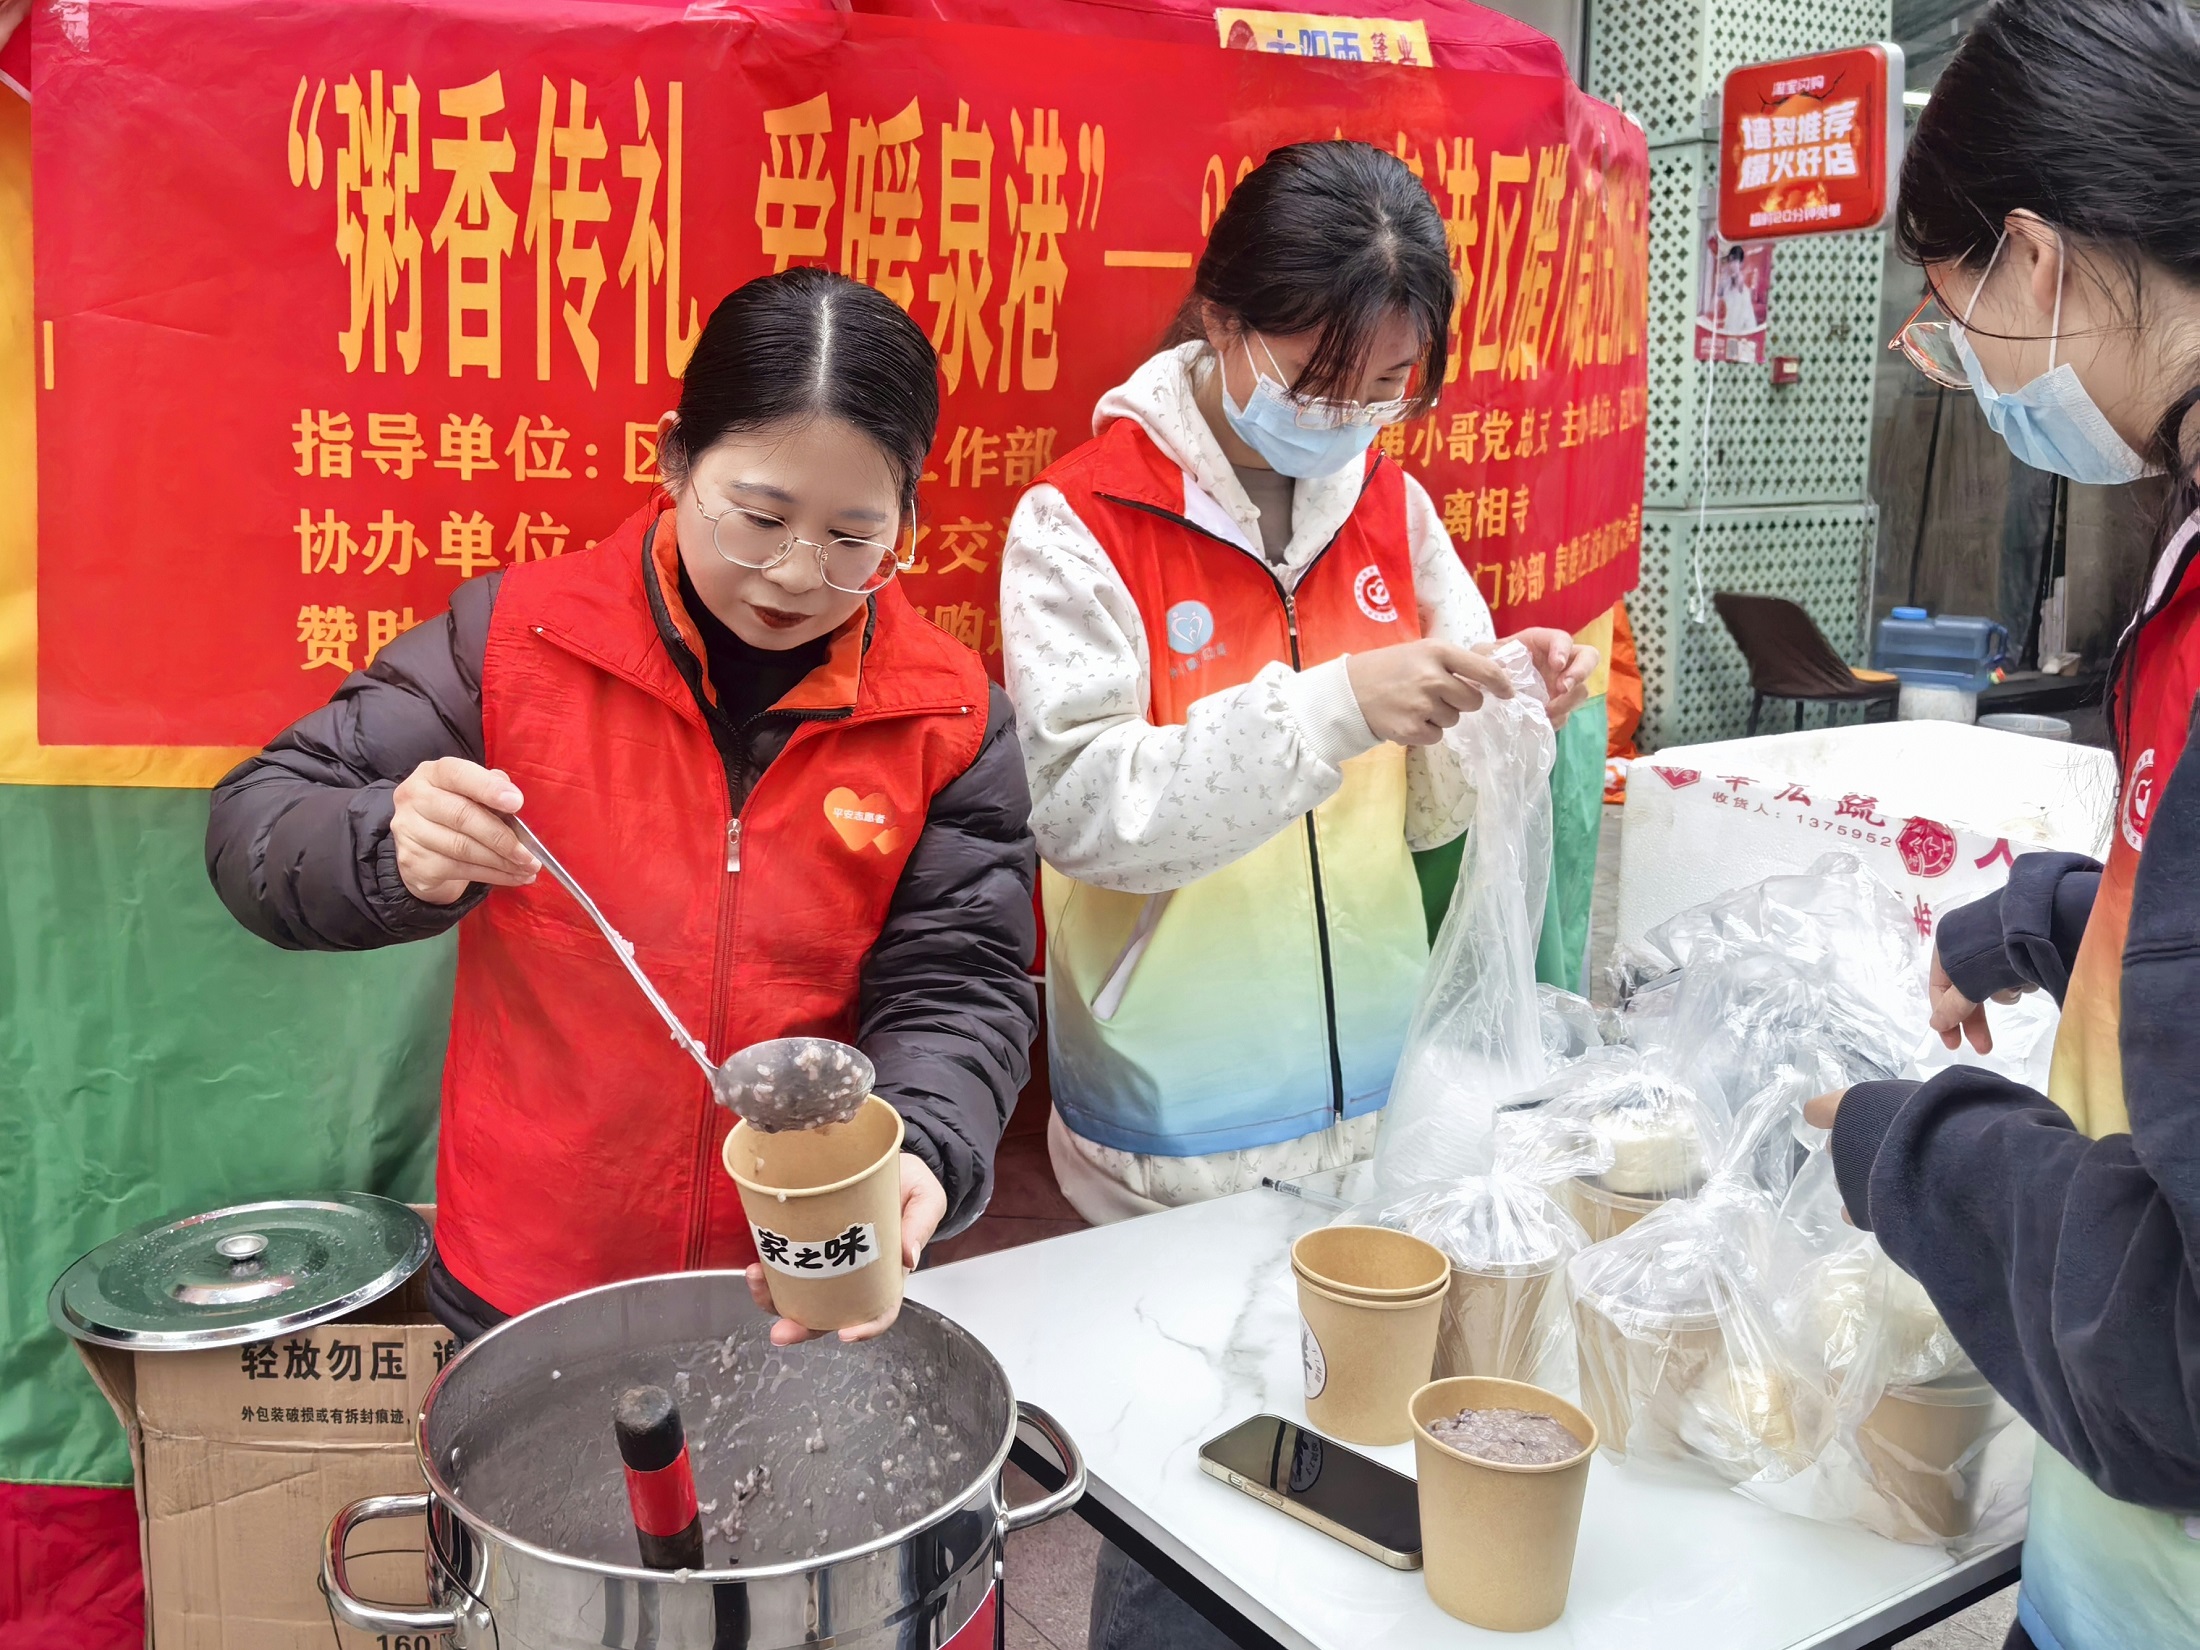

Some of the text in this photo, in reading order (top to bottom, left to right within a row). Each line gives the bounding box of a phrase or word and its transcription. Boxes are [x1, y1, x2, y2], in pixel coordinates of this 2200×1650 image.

[1740, 100, 1859, 151] 墙裂推荐
[1737, 142, 1858, 191] 爆火好店
[918, 425, 1058, 489] 作部
[833, 807, 887, 825] 平安志愿者
[757, 1225, 871, 1270] 家之味
[241, 1338, 407, 1382] 轻放勿压
